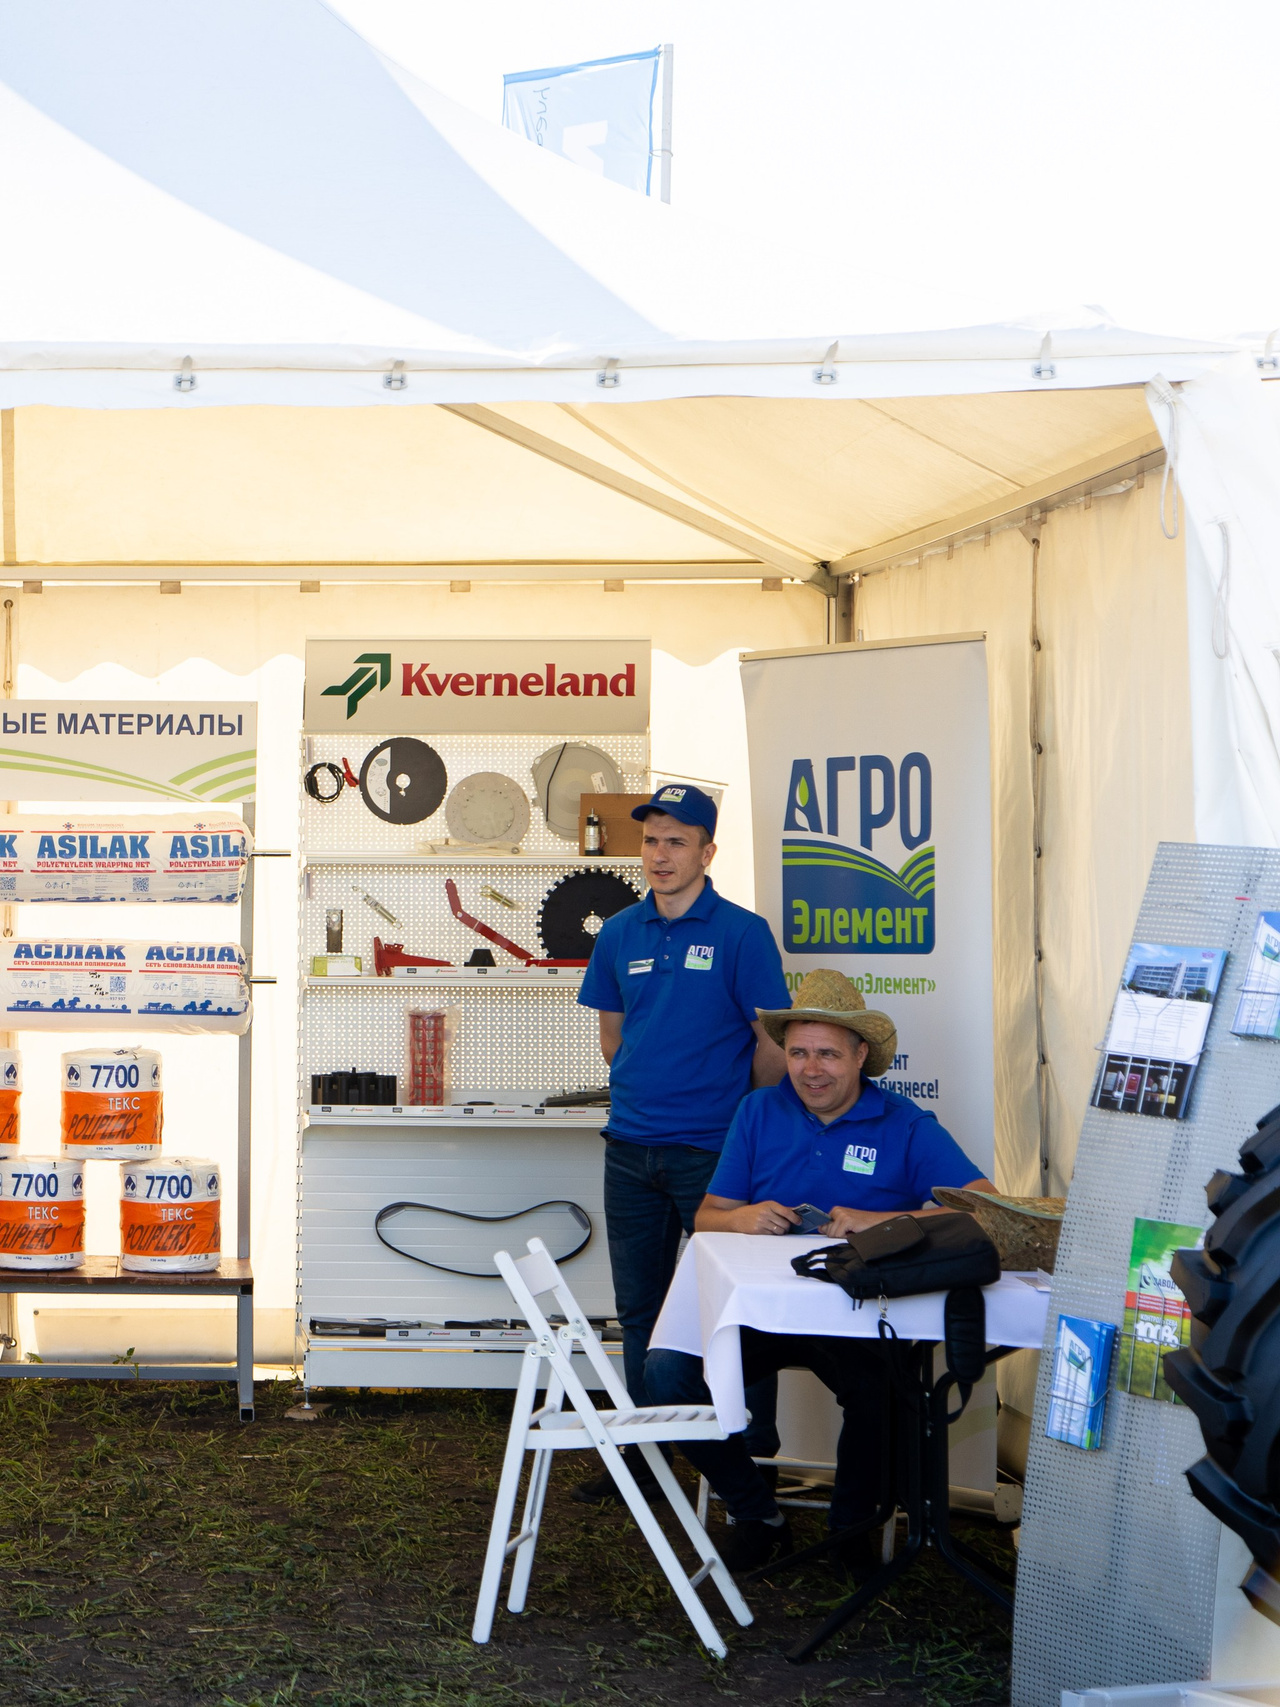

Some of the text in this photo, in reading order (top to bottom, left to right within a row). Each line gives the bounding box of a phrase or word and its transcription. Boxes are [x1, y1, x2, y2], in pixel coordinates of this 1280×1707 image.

[400, 662, 637, 698] Kverneland
[57, 712, 244, 736] МАТЕРИАЛЫ
[664, 787, 686, 797] АГРО
[783, 751, 932, 852] АГРО
[36, 834, 150, 859] ASILAK
[169, 834, 240, 859] ASIL
[2, 860, 18, 868] NET
[792, 899, 929, 944] Элемент
[687, 944, 715, 958] АГРО
[1265, 933, 1279, 948] АГР
[145, 945, 236, 962] АСІЛА
[850, 972, 937, 995] оЭлемент»
[90, 1064, 140, 1088] 7700
[108, 1097, 140, 1110] ТЕКС
[66, 1112, 143, 1140] POLIPLEKS
[845, 1144, 877, 1162] АГРО
[11, 1173, 59, 1197] 7700
[145, 1174, 193, 1199] 7700
[28, 1206, 59, 1220] ТЕКС
[161, 1207, 194, 1221] ТЕКС
[124, 1223, 196, 1252] POLIPLEKS
